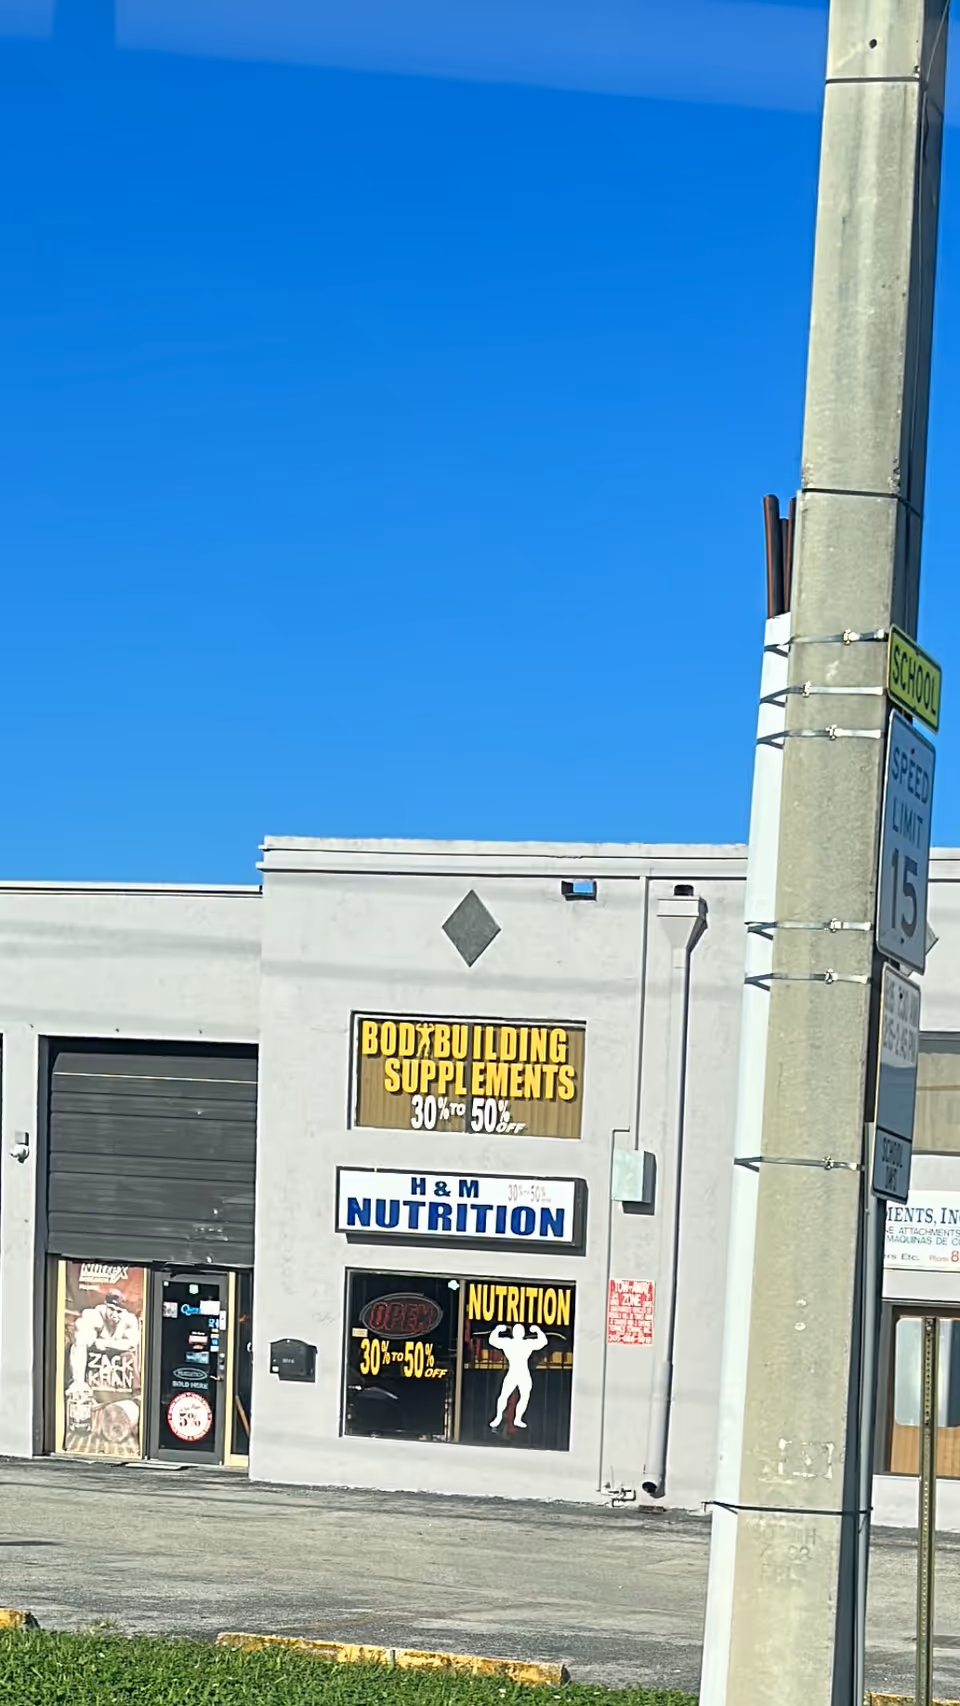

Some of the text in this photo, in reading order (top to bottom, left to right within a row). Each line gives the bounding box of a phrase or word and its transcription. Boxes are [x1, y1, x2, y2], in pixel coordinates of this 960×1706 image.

[893, 645, 936, 715] SCHOOL
[891, 747, 930, 804] SPEED
[892, 803, 923, 849] LIMIT
[890, 847, 919, 939] 15
[383, 1058, 576, 1100] SUPPLEMENTS
[411, 1094, 527, 1134] 30% TO 50% OFF
[410, 1177, 480, 1199] H & M
[347, 1197, 565, 1238] NUTRITION
[899, 1226, 960, 1237] ATTACHMENTS
[936, 1237, 947, 1246] DE
[468, 1284, 571, 1326] NUTRITION
[621, 1294, 642, 1307] ZONE
[88, 1352, 134, 1371] ZACK
[360, 1338, 447, 1379] 30% TO 50% OFF
[88, 1370, 134, 1389] KHAN
